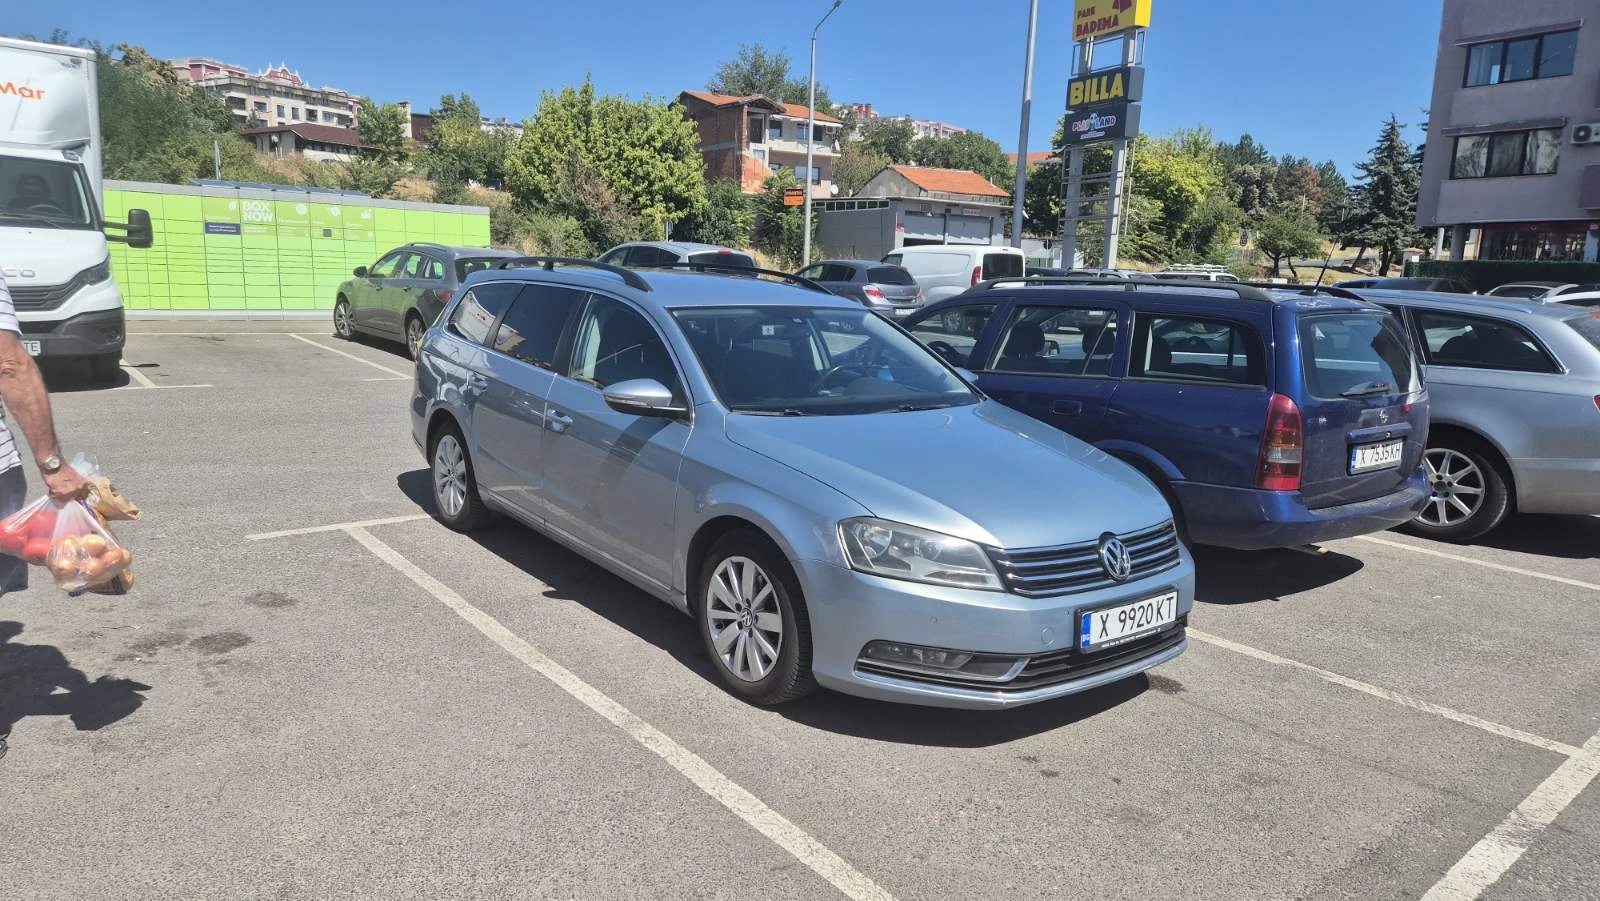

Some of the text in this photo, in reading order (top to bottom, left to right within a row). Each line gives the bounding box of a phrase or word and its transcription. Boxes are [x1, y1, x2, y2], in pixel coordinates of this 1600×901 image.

[1077, 6, 1096, 20] PARK
[1076, 14, 1119, 37] BADEMA
[1069, 72, 1124, 106] BILLA
[242, 201, 270, 212] BOX
[243, 211, 274, 222] NOW
[1360, 447, 1367, 465] X
[1099, 612, 1110, 639] X
[1118, 596, 1175, 633] 9920KT
